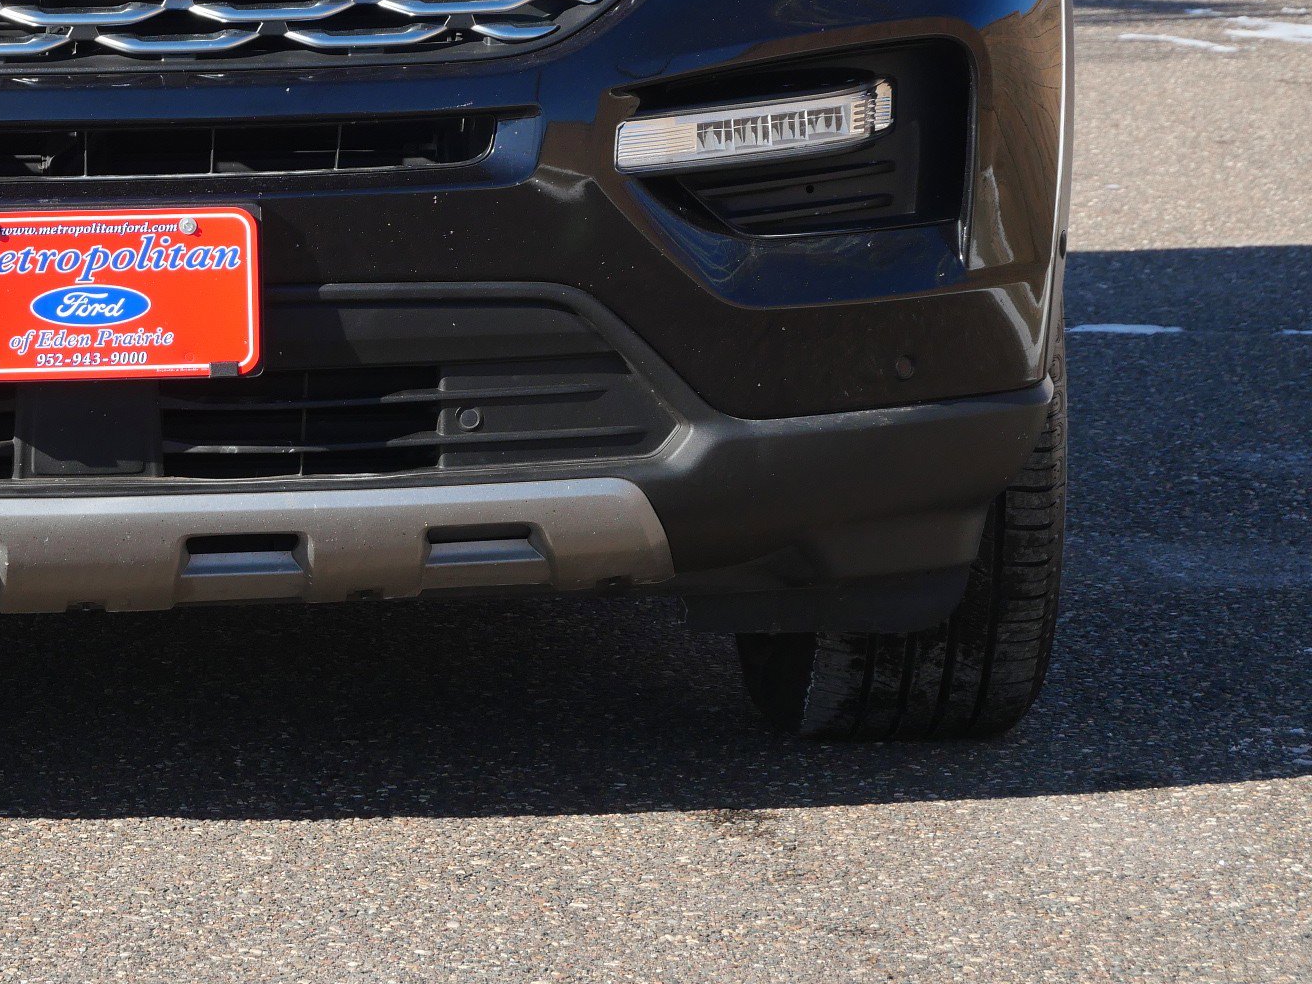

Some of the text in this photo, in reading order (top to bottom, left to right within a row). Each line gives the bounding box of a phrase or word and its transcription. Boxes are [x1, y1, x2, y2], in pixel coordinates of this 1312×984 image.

[0, 222, 178, 237] www.metropolitanford.com
[56, 291, 125, 317] Ford
[9, 327, 175, 355] of Eden Prairie
[36, 351, 148, 367] 952-943-9000
